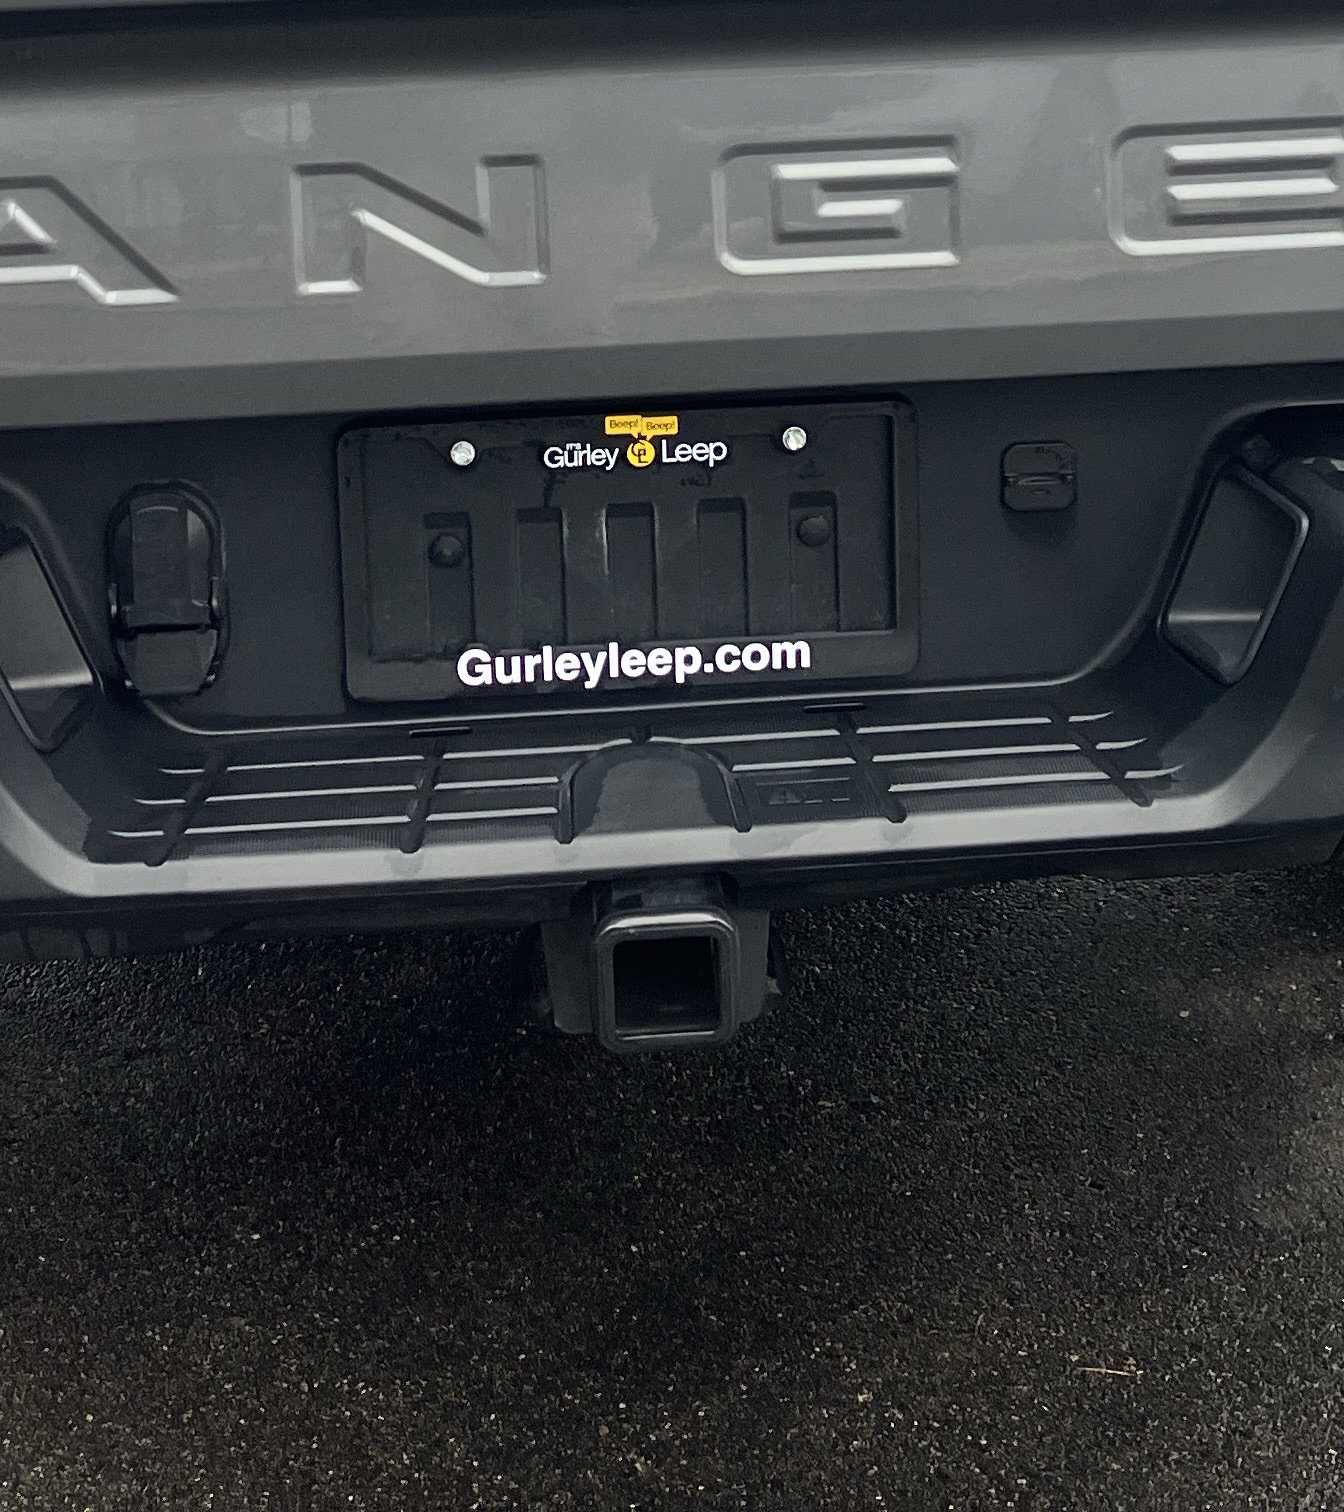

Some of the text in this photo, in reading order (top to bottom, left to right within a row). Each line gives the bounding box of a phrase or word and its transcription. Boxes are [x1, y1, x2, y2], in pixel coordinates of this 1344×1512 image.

[543, 443, 620, 471] Gurley
[661, 439, 728, 468] Leep
[456, 640, 812, 689] Gurleyleep.com
